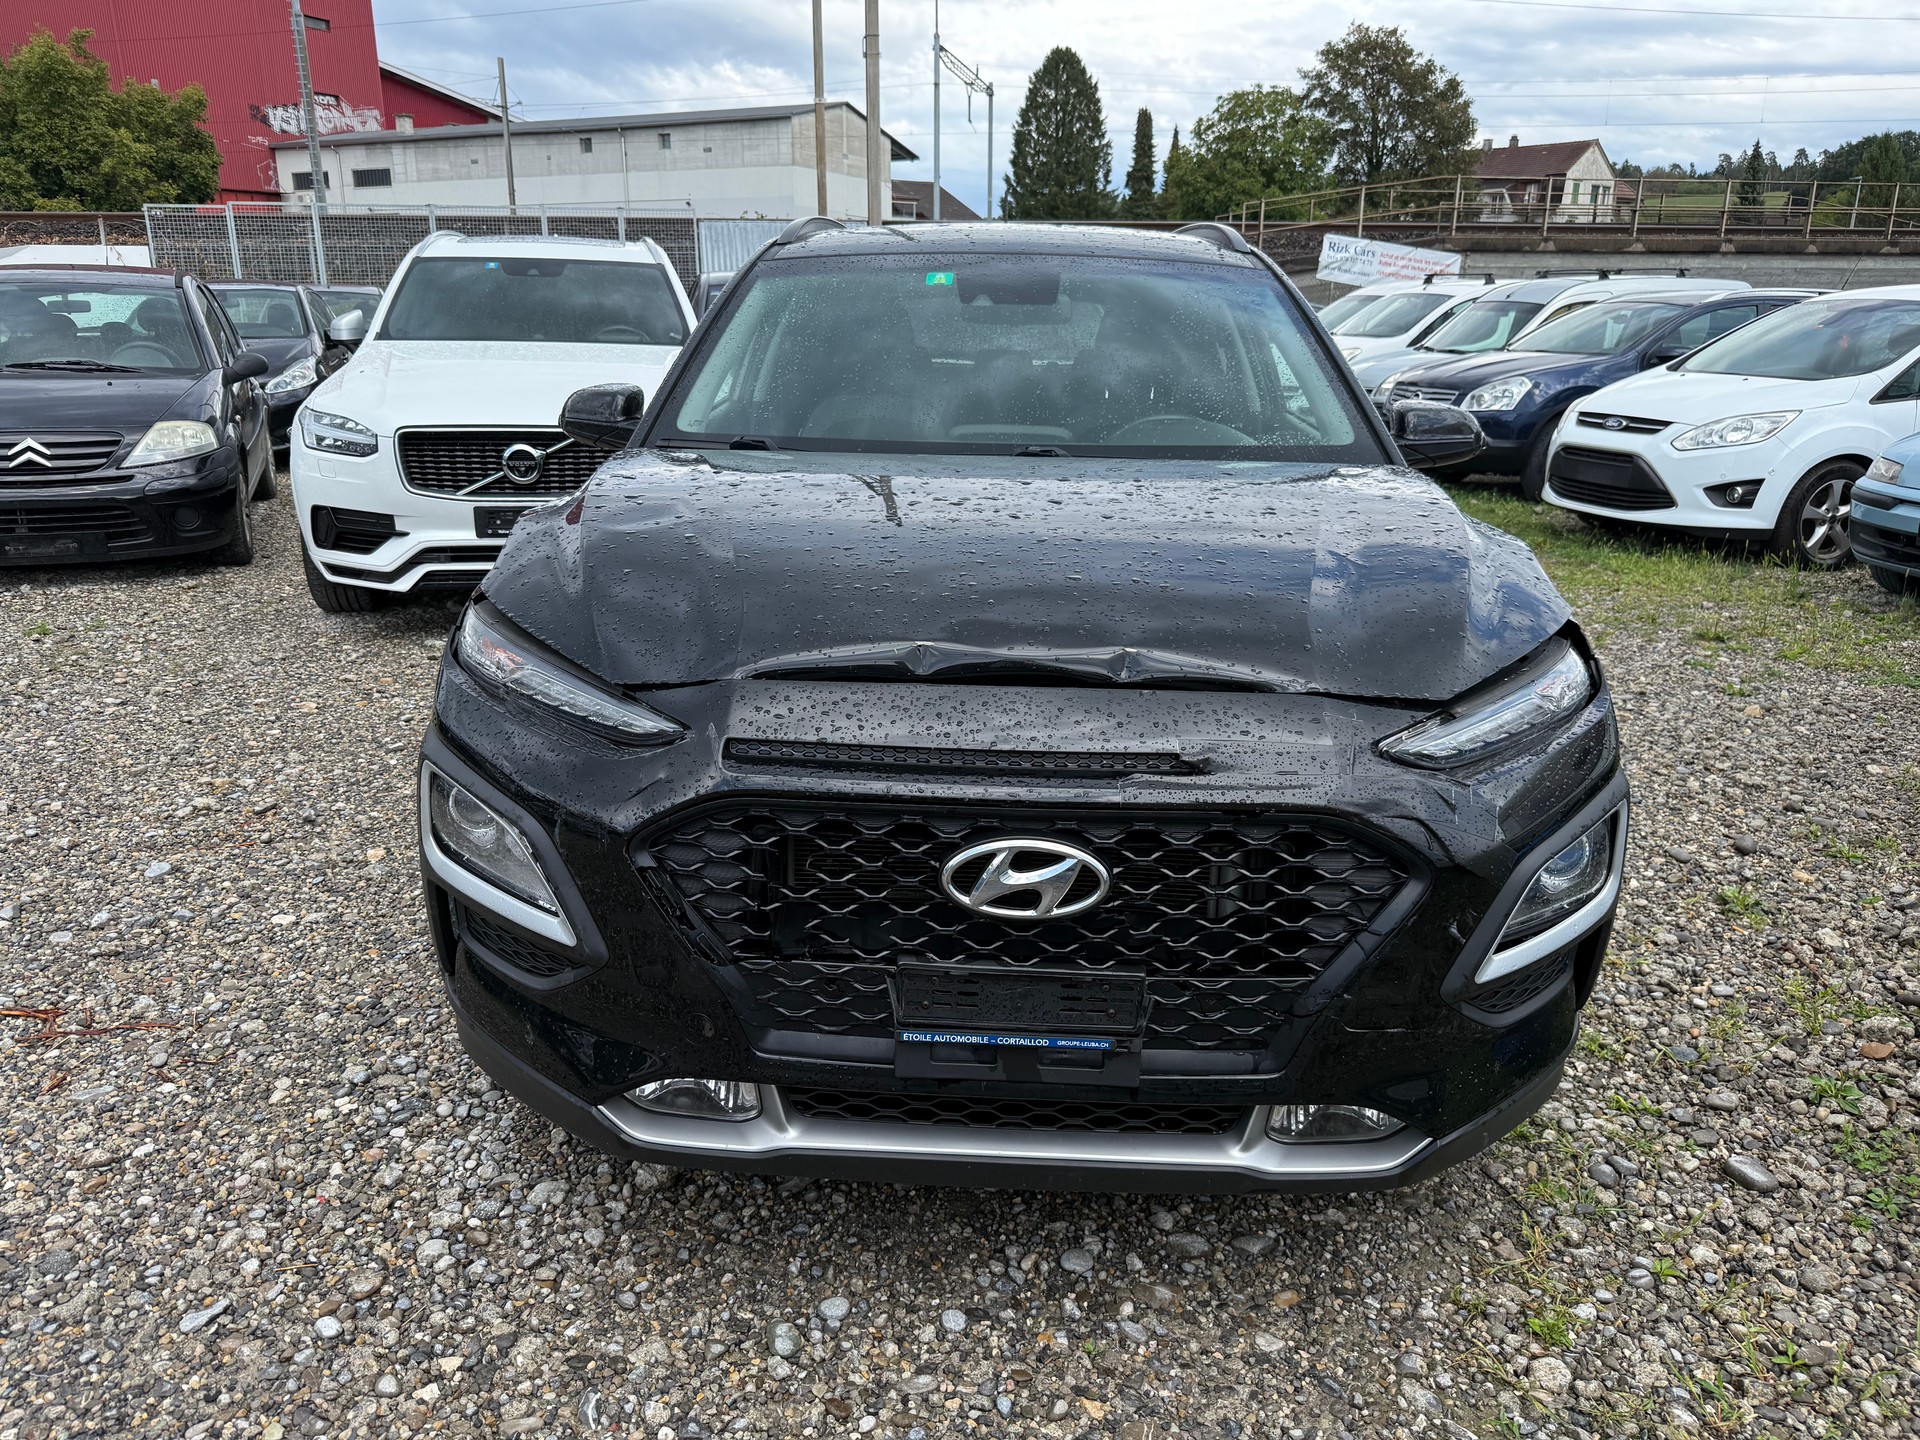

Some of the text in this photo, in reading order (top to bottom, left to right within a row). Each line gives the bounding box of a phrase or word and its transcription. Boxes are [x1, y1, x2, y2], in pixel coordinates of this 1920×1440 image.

[1328, 241, 1376, 258] Rizk Cars
[903, 1032, 932, 1042] ÉTOILE
[933, 1034, 989, 1044] AUTOMOBILE
[997, 1037, 1050, 1046] CORTAILLOD
[1056, 1039, 1109, 1048] GROUPE-LEUBA.CH
